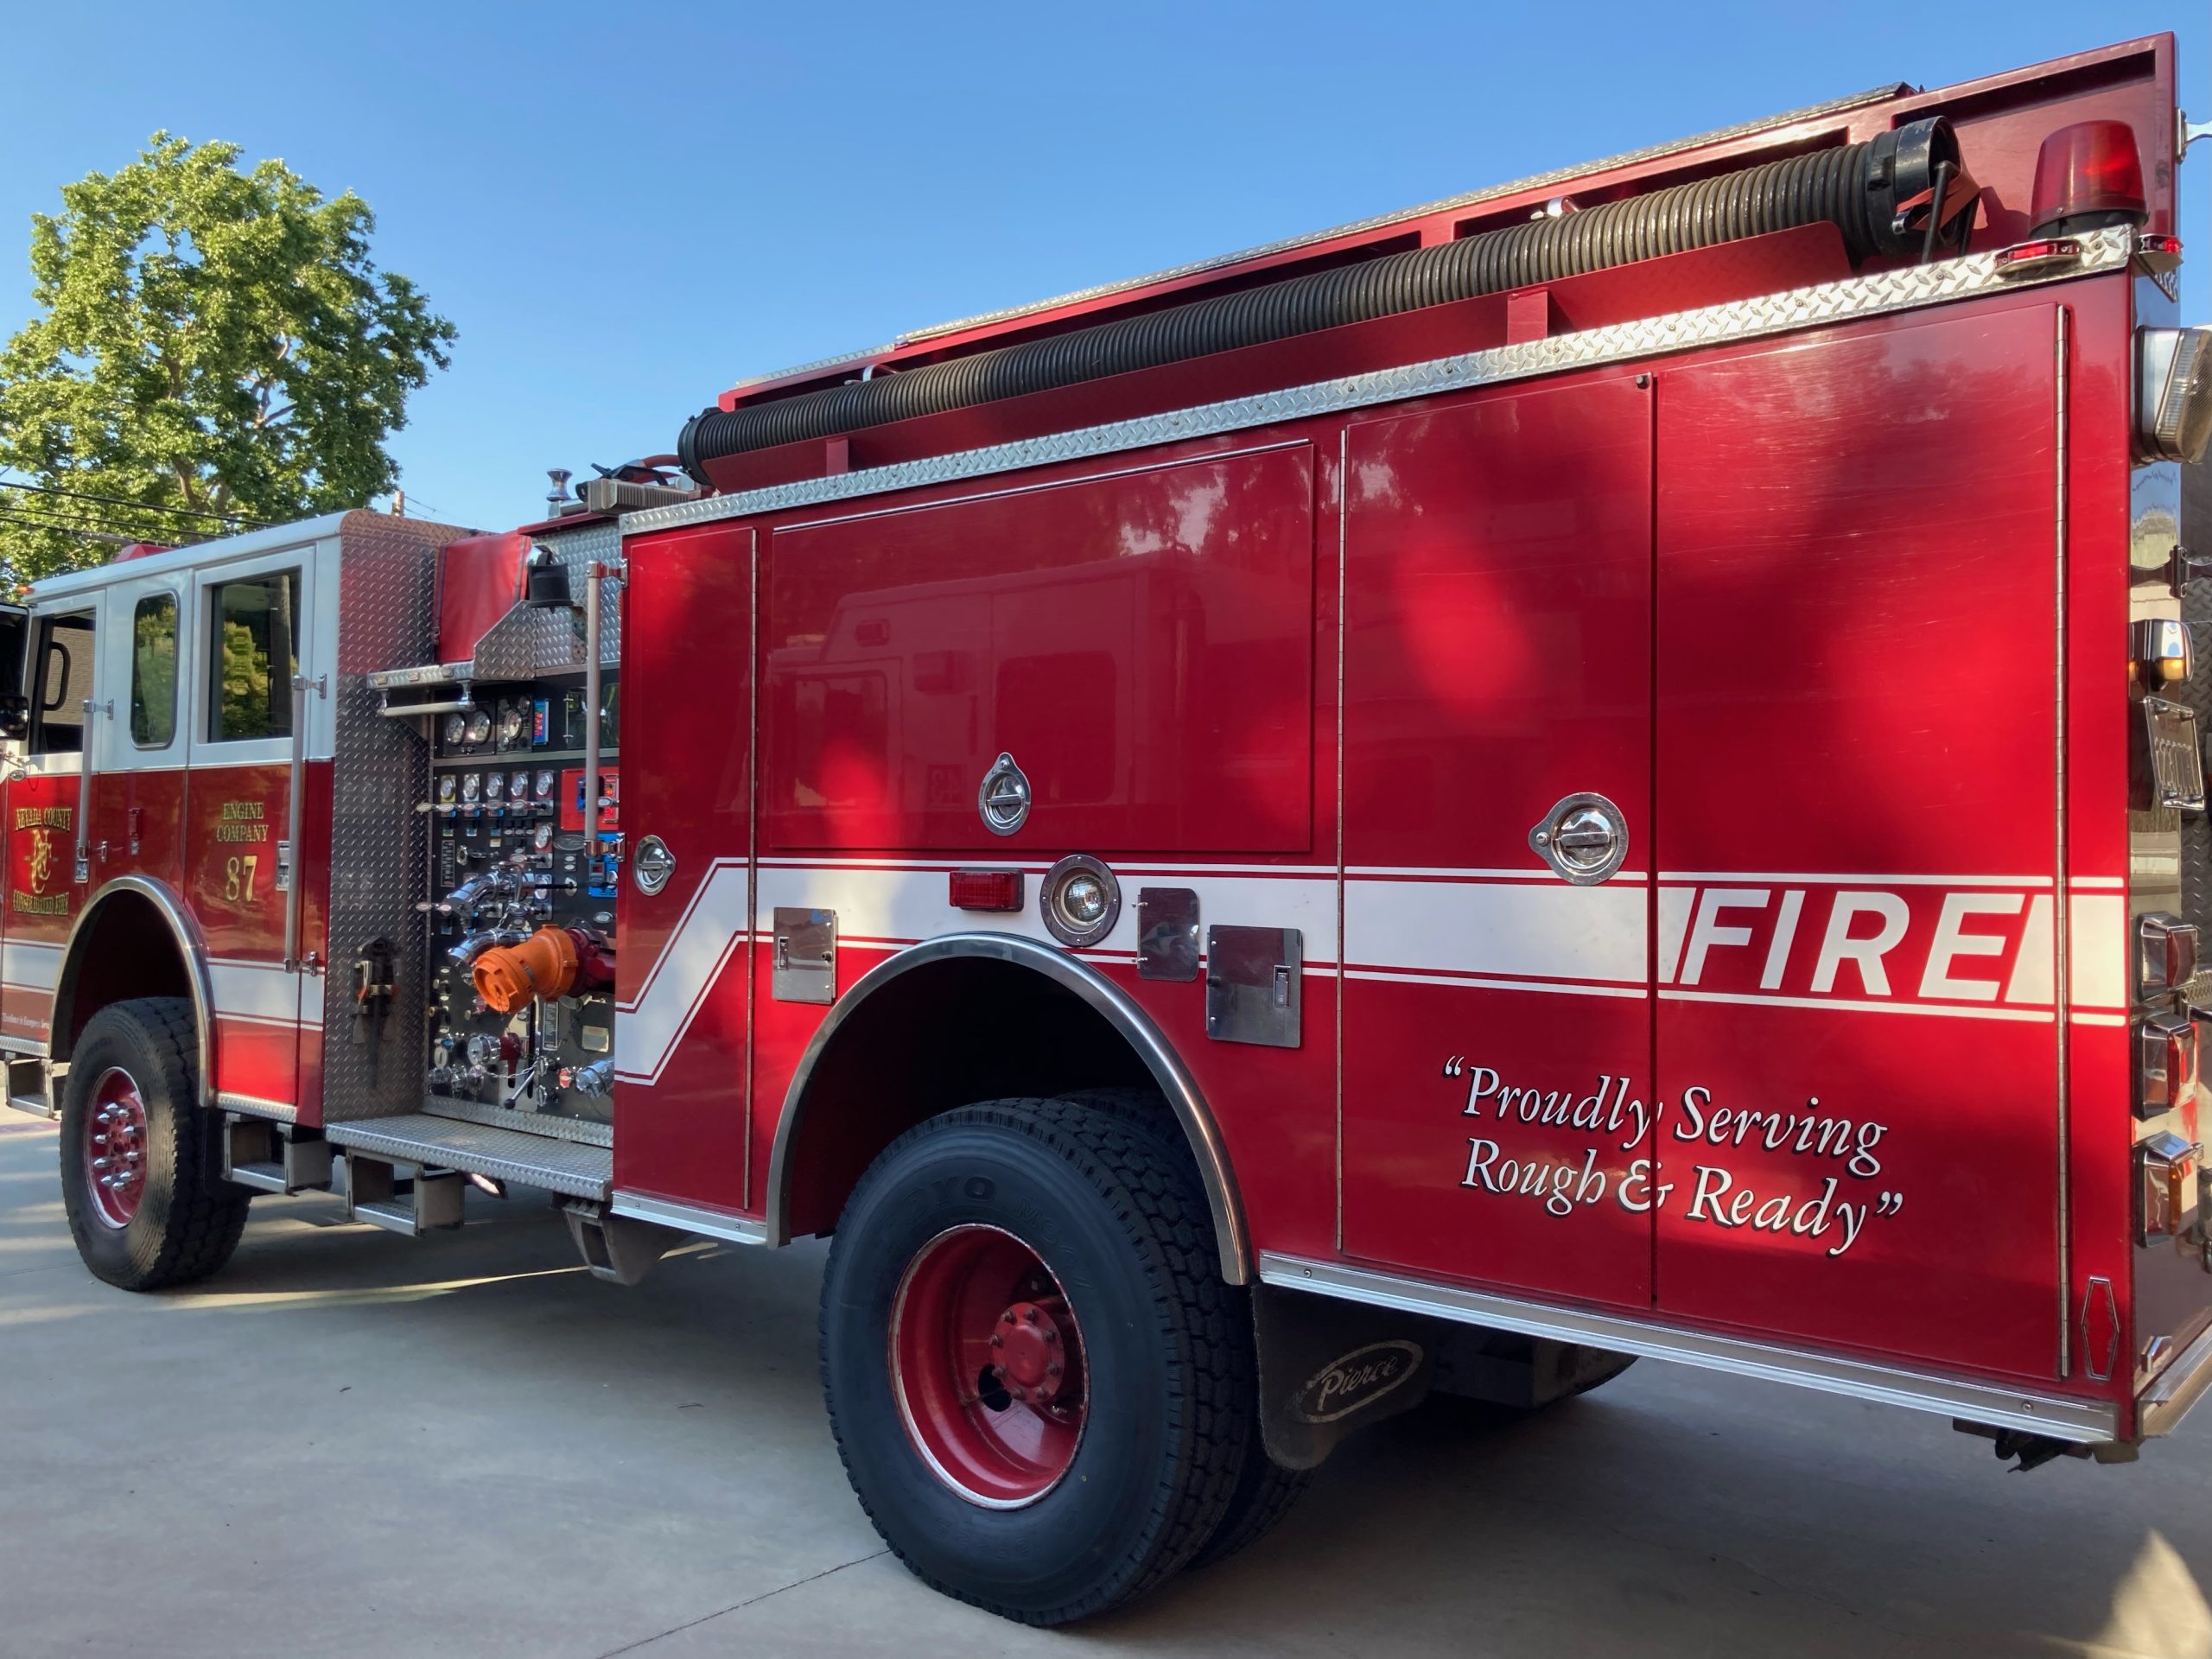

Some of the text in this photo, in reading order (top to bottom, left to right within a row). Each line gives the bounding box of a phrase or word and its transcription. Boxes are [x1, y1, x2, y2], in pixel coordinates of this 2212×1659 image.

[43, 808, 72, 831] COUNTY
[216, 824, 269, 842] COMPANY
[222, 801, 264, 820] ENGINE
[226, 855, 257, 902] 87
[1680, 888, 2025, 1001] FIRE
[1674, 1086, 1888, 1177] Serving
[1460, 1137, 1607, 1216] Rough
[1618, 1159, 1674, 1211] &
